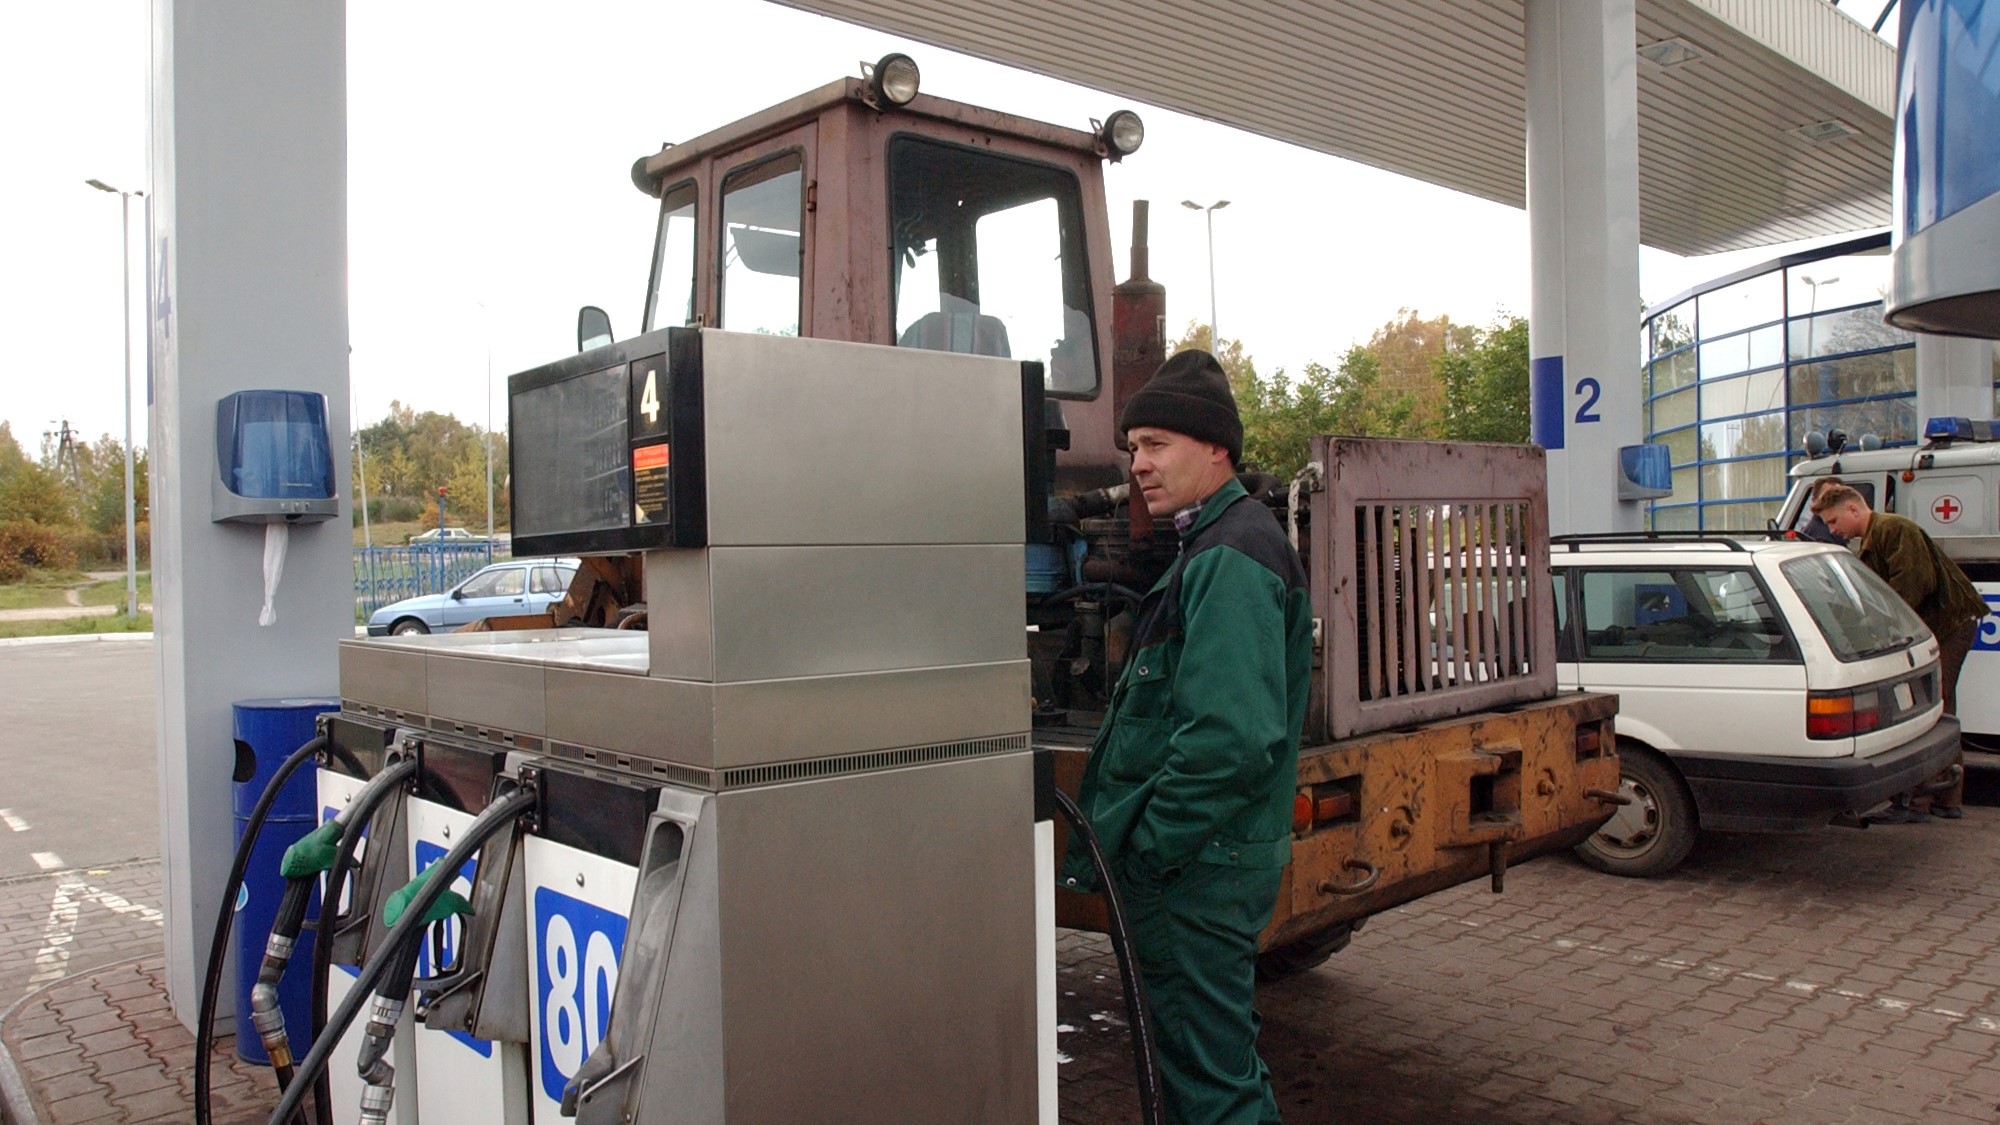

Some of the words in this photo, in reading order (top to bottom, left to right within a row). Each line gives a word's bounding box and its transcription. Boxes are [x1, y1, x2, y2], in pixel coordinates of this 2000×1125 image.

[157, 237, 171, 339] 4
[640, 370, 660, 423] 4
[1575, 377, 1601, 424] 2
[546, 914, 619, 1079] 80
